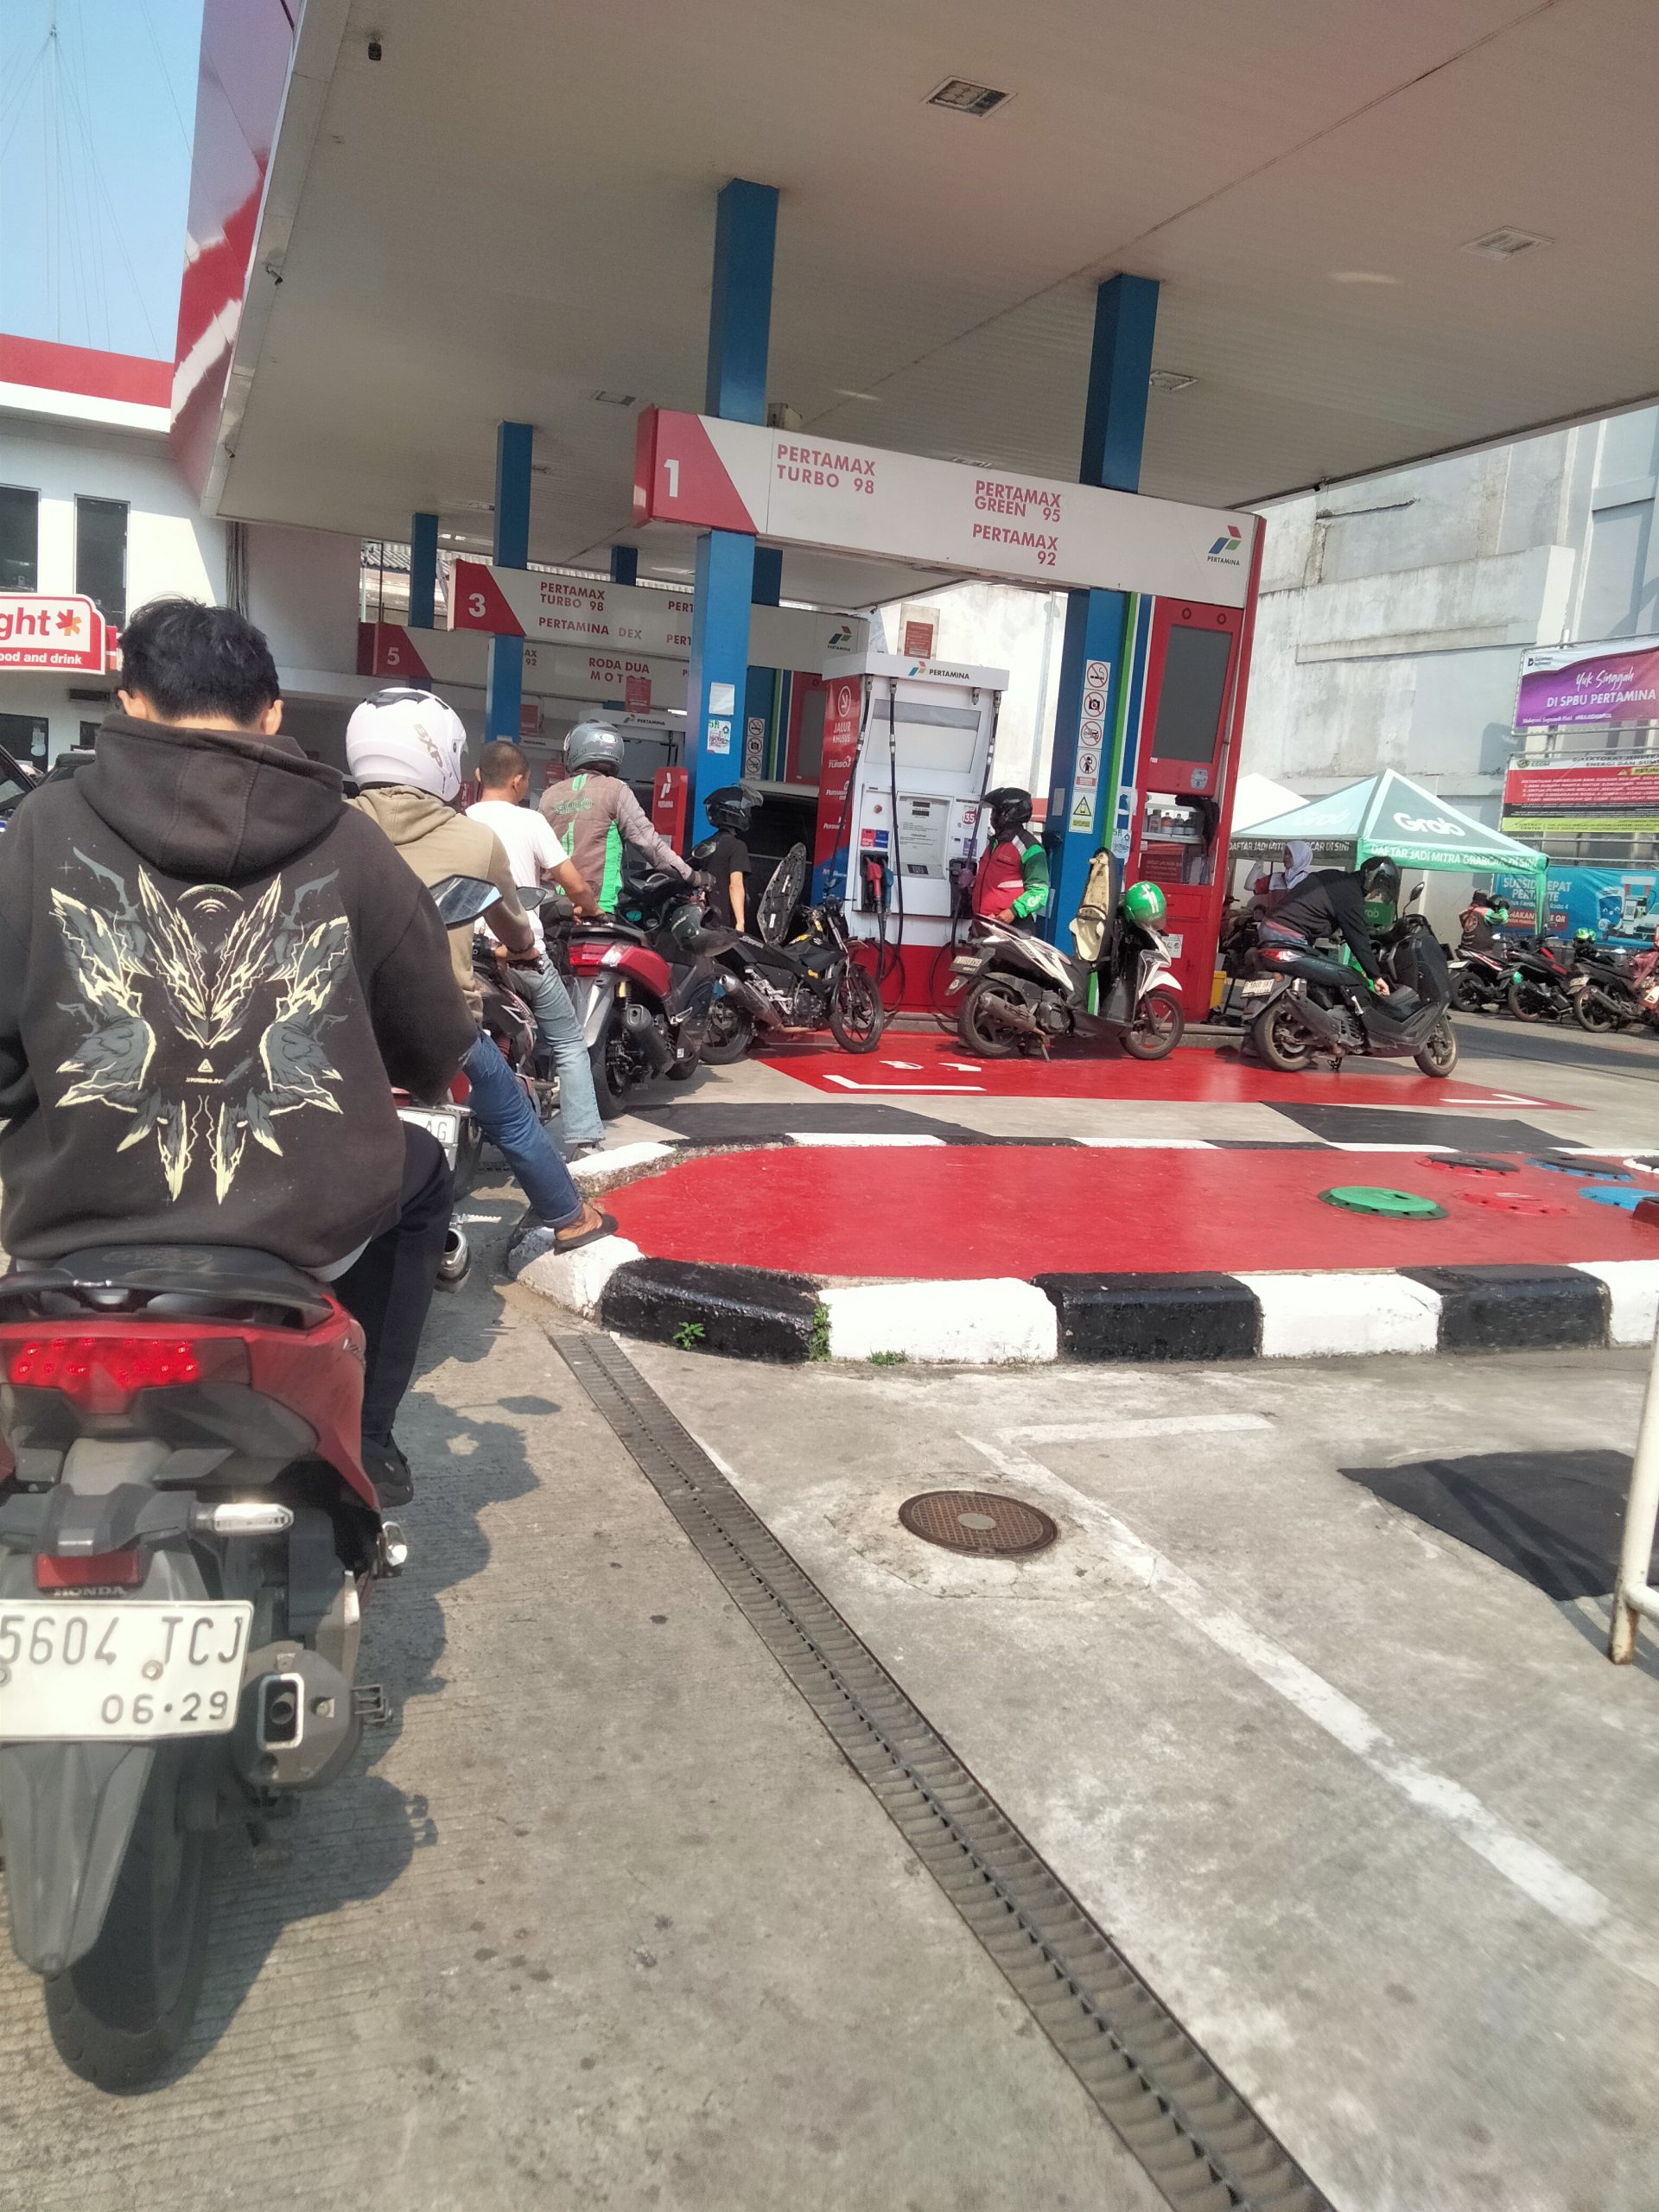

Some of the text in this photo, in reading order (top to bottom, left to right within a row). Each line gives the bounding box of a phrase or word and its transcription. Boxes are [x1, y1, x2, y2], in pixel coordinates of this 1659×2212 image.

[777, 443, 876, 477] PERTAMAX
[663, 458, 680, 499] 1
[776, 464, 874, 495] TURBO 98
[975, 480, 1062, 508] PERTAMAX
[974, 495, 1061, 523] GREEN 95
[972, 523, 1059, 551] PERTAMAX
[1037, 550, 1057, 567] 92
[1206, 555, 1241, 567] PERTAMINA
[539, 581, 606, 601] PERTAMAX
[467, 593, 486, 618] 3
[539, 594, 605, 613] TURBO 98
[537, 616, 643, 640] PERTAMINA DEX
[23, 652, 48, 664] and
[50, 653, 83, 665] drink
[386, 647, 401, 666] 5
[588, 657, 650, 674] RODA DUA
[589, 670, 646, 683] MOT
[928, 668, 970, 681] PERTAMINA
[1575, 666, 1635, 692] Yuk Singgah
[1546, 689, 1657, 708] DI SPBU PERTAMINA
[833, 721, 852, 734] JALUR
[1393, 811, 1466, 836] Grab
[1335, 842, 1350, 852] SINI
[1370, 845, 1408, 858] DAFTAR
[1409, 849, 1431, 861] JADI
[1431, 852, 1461, 864] MITRA
[53, 1586, 127, 1597] HONDA
[0, 1614, 244, 1666] 5604 TCJ
